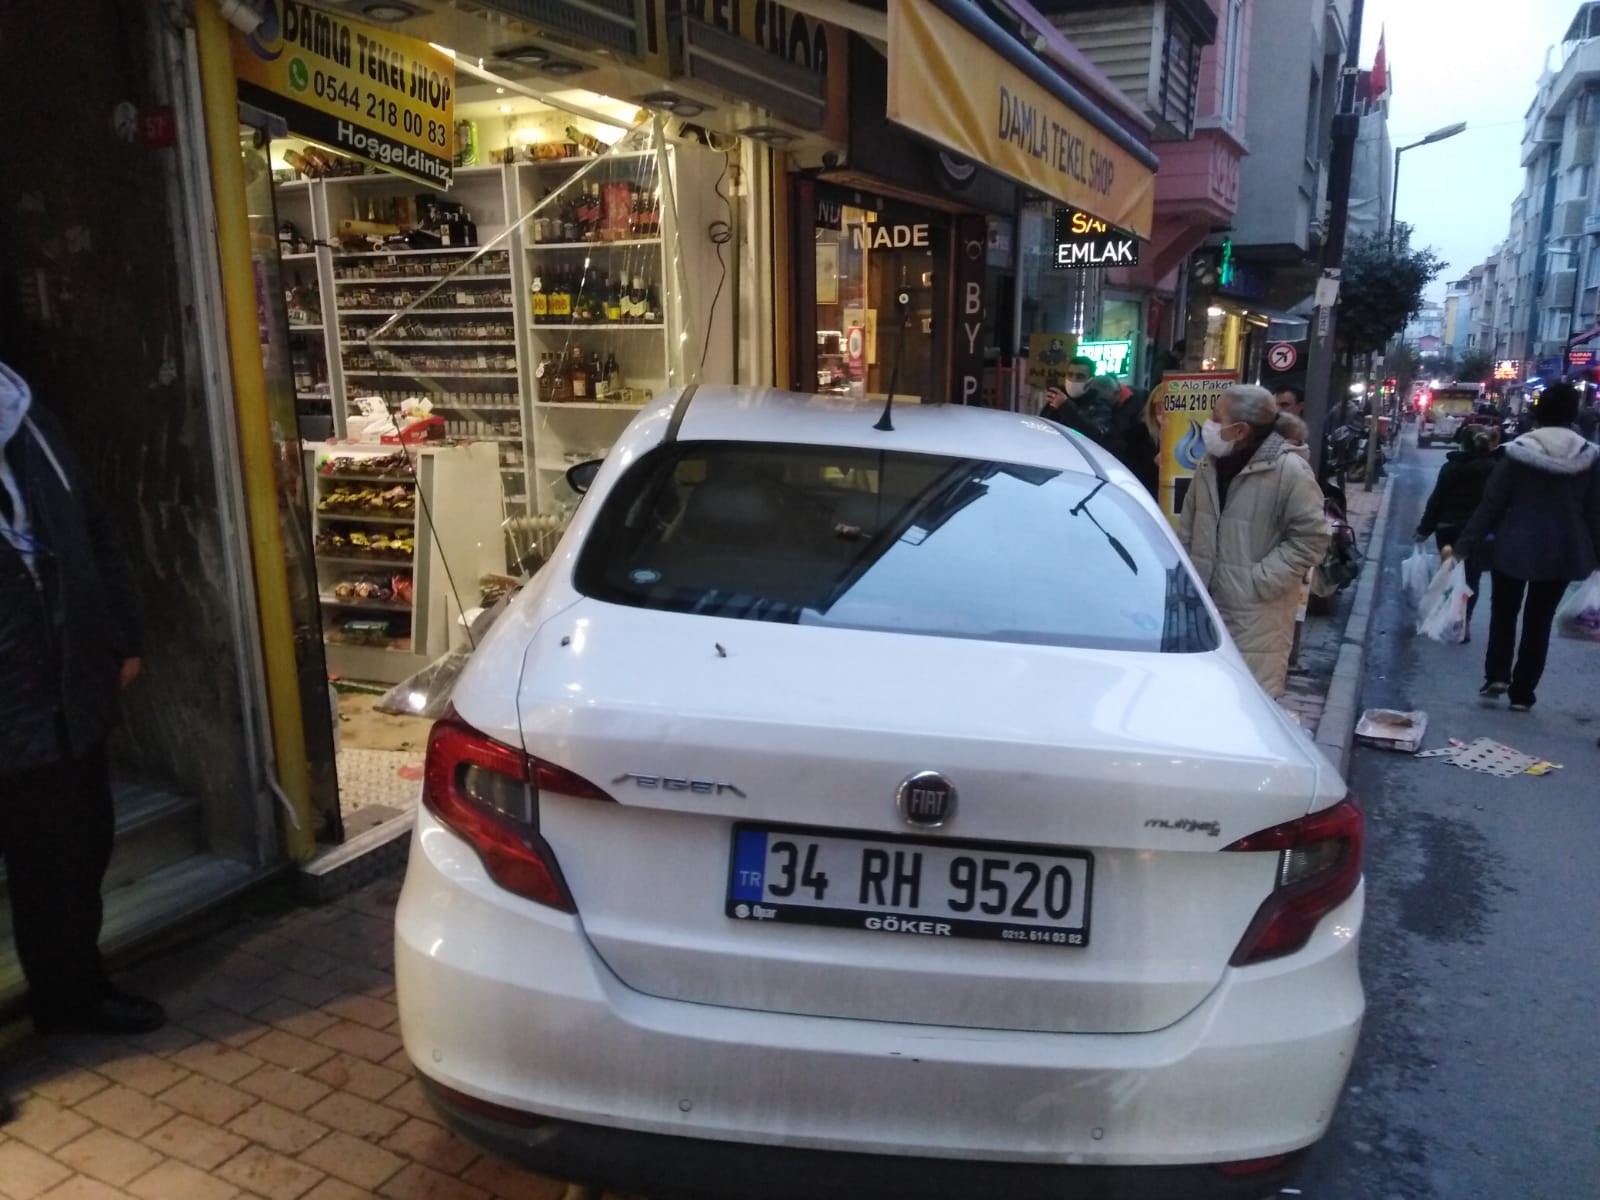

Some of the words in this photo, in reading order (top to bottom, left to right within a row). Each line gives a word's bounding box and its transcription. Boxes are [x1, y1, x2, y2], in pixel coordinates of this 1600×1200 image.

[282, 0, 351, 69] DAMLA
[357, 33, 406, 93] TEKEL
[409, 61, 451, 112] SHOP
[313, 70, 361, 112] 0544
[366, 93, 398, 127] 218
[403, 109, 423, 138] 00
[428, 119, 446, 147] 83
[998, 86, 1049, 163] DAMLA
[1051, 122, 1087, 185] TEKEL
[1088, 147, 1115, 197] SHOP
[853, 223, 930, 250] MADE
[1057, 240, 1134, 265] EMLAK
[1180, 380, 1200, 391] Alo
[1164, 394, 1187, 412] 0544
[1189, 393, 1207, 412] 218
[911, 788, 946, 816] FIAT
[739, 869, 762, 888] TR
[767, 840, 829, 901] 34
[859, 848, 923, 909] RH
[947, 856, 1073, 921] 9520
[864, 915, 952, 936] GÖKER
